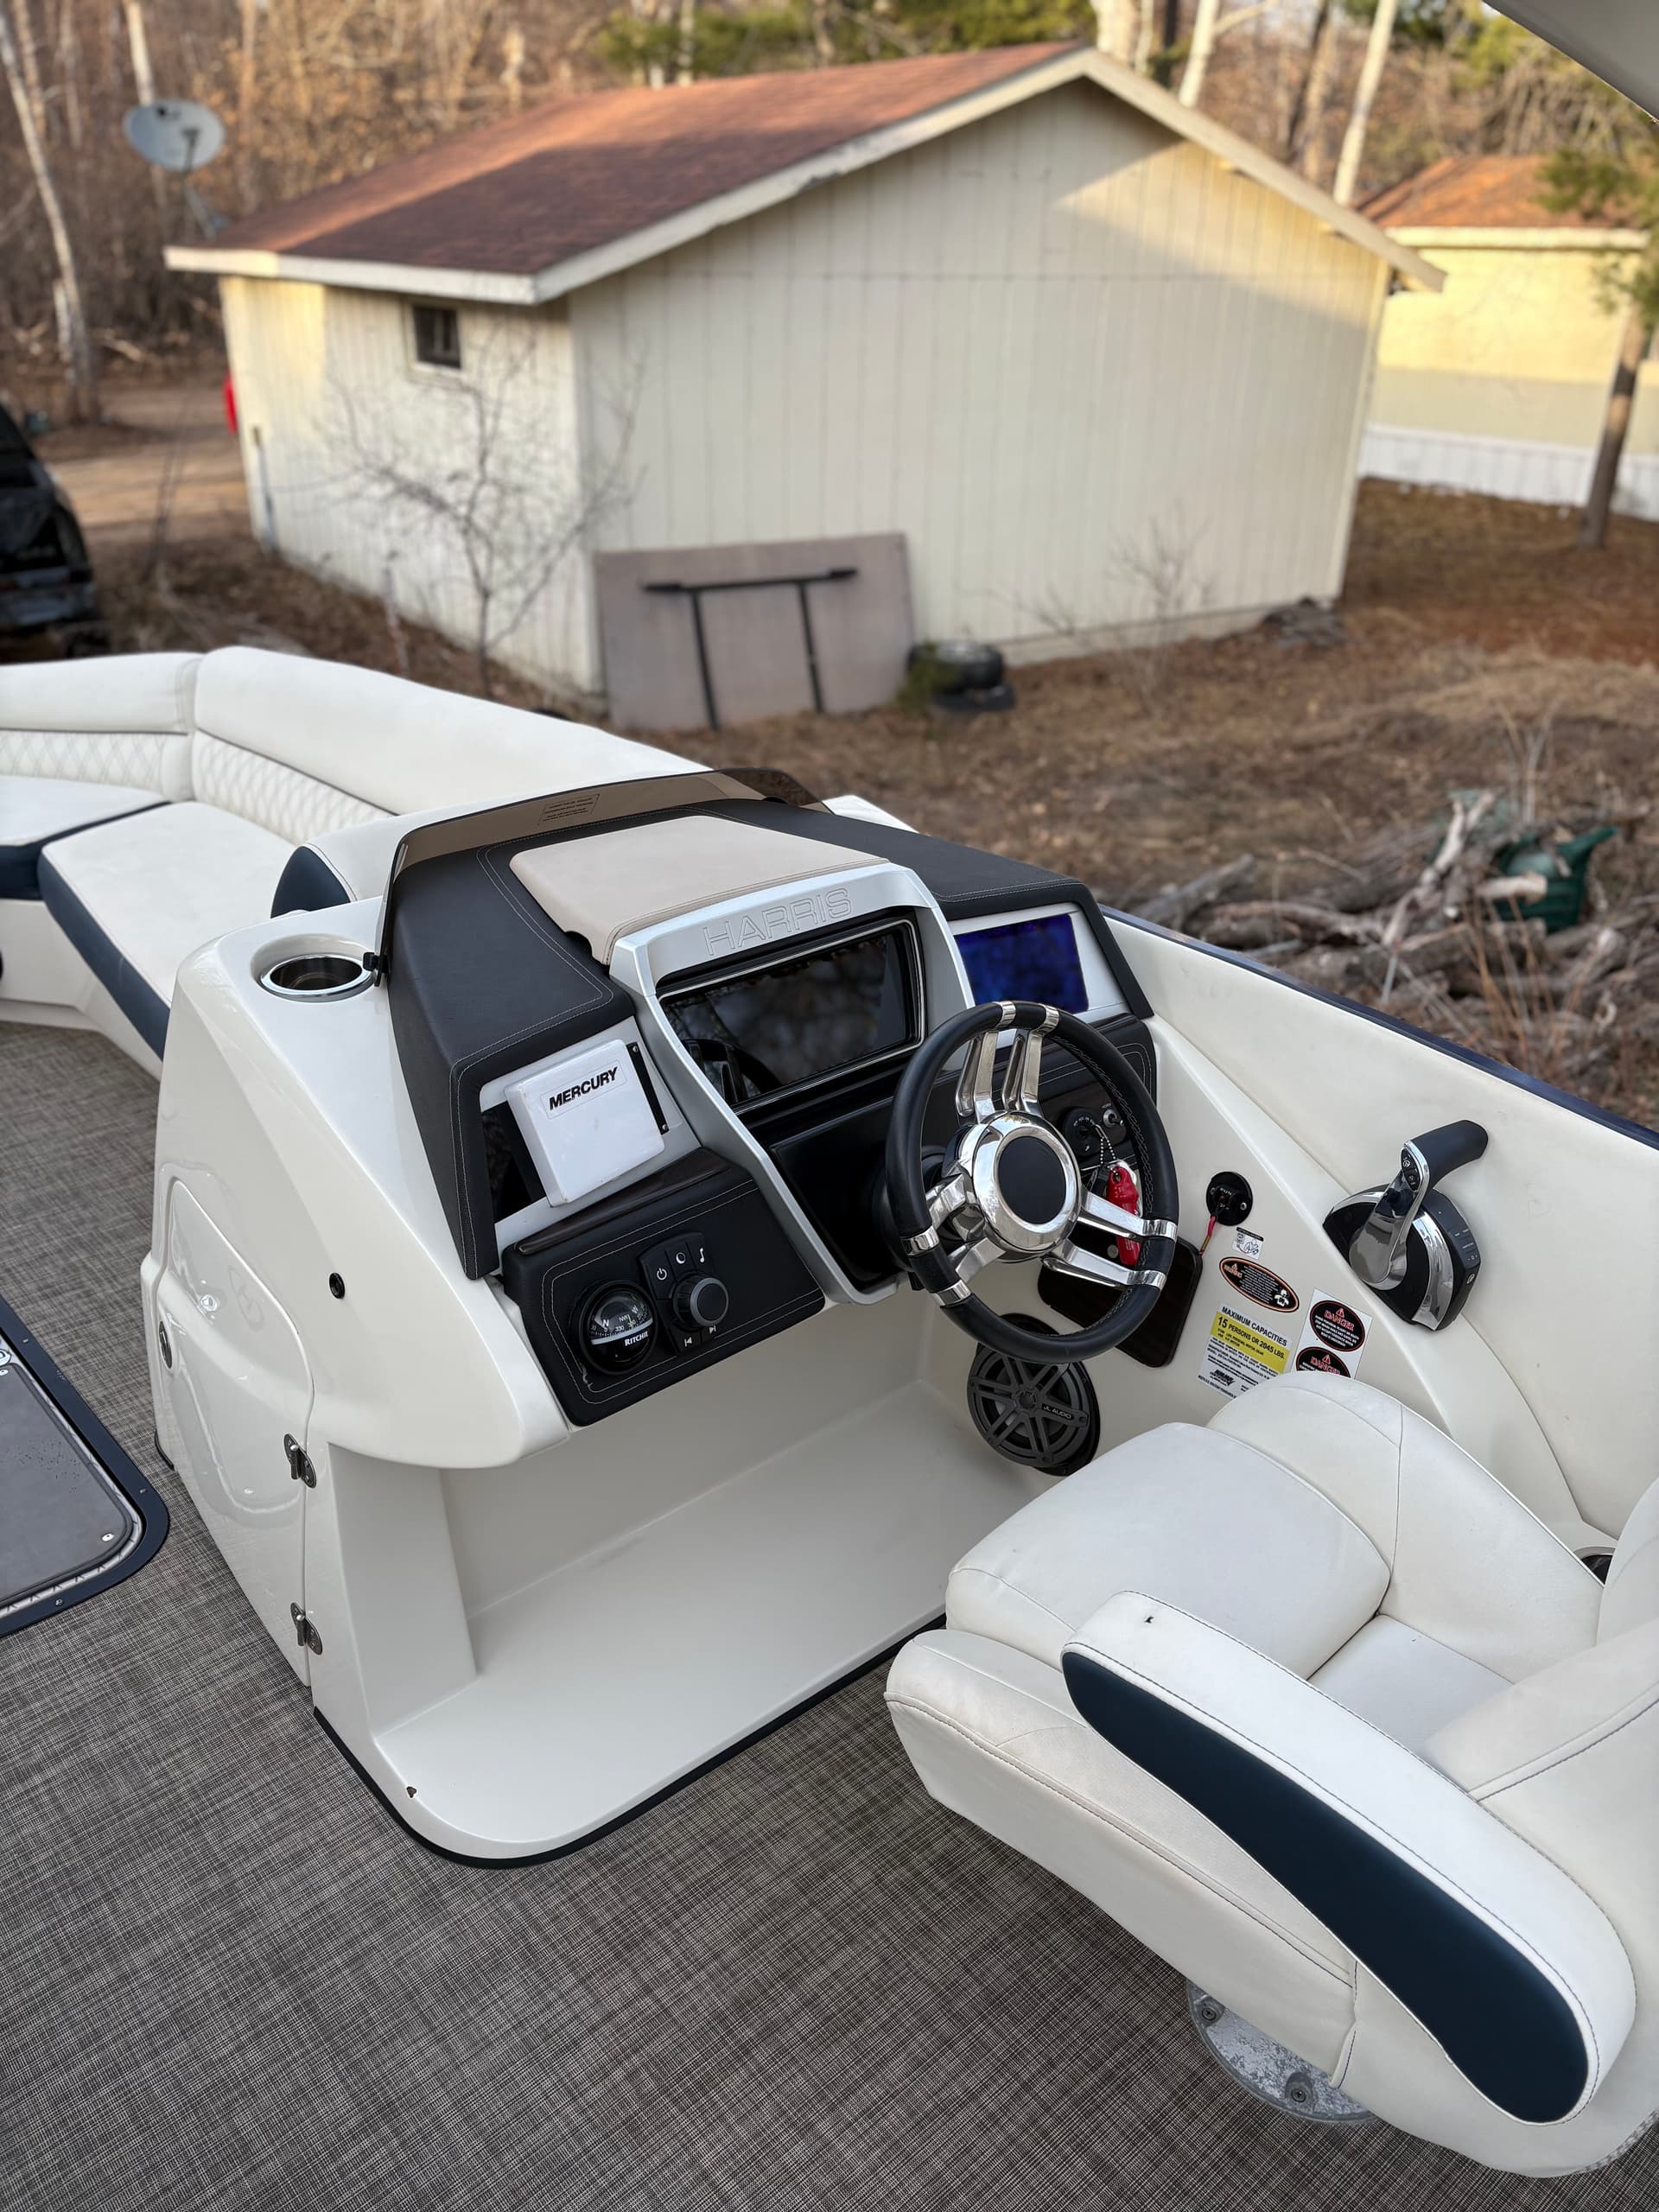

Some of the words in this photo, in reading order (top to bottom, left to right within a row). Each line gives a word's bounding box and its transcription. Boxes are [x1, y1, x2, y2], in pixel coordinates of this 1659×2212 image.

[702, 888, 852, 957] HARRIS
[549, 1066, 618, 1111] MERCURY
[602, 1319, 609, 1327] N
[1217, 1316, 1228, 1328] 15
[1228, 1325, 1251, 1340] PERSONS
[1251, 1336, 1260, 1345] OR
[1221, 1306, 1251, 1326] MAXIMUM
[1251, 1322, 1287, 1346] CAPACITIES
